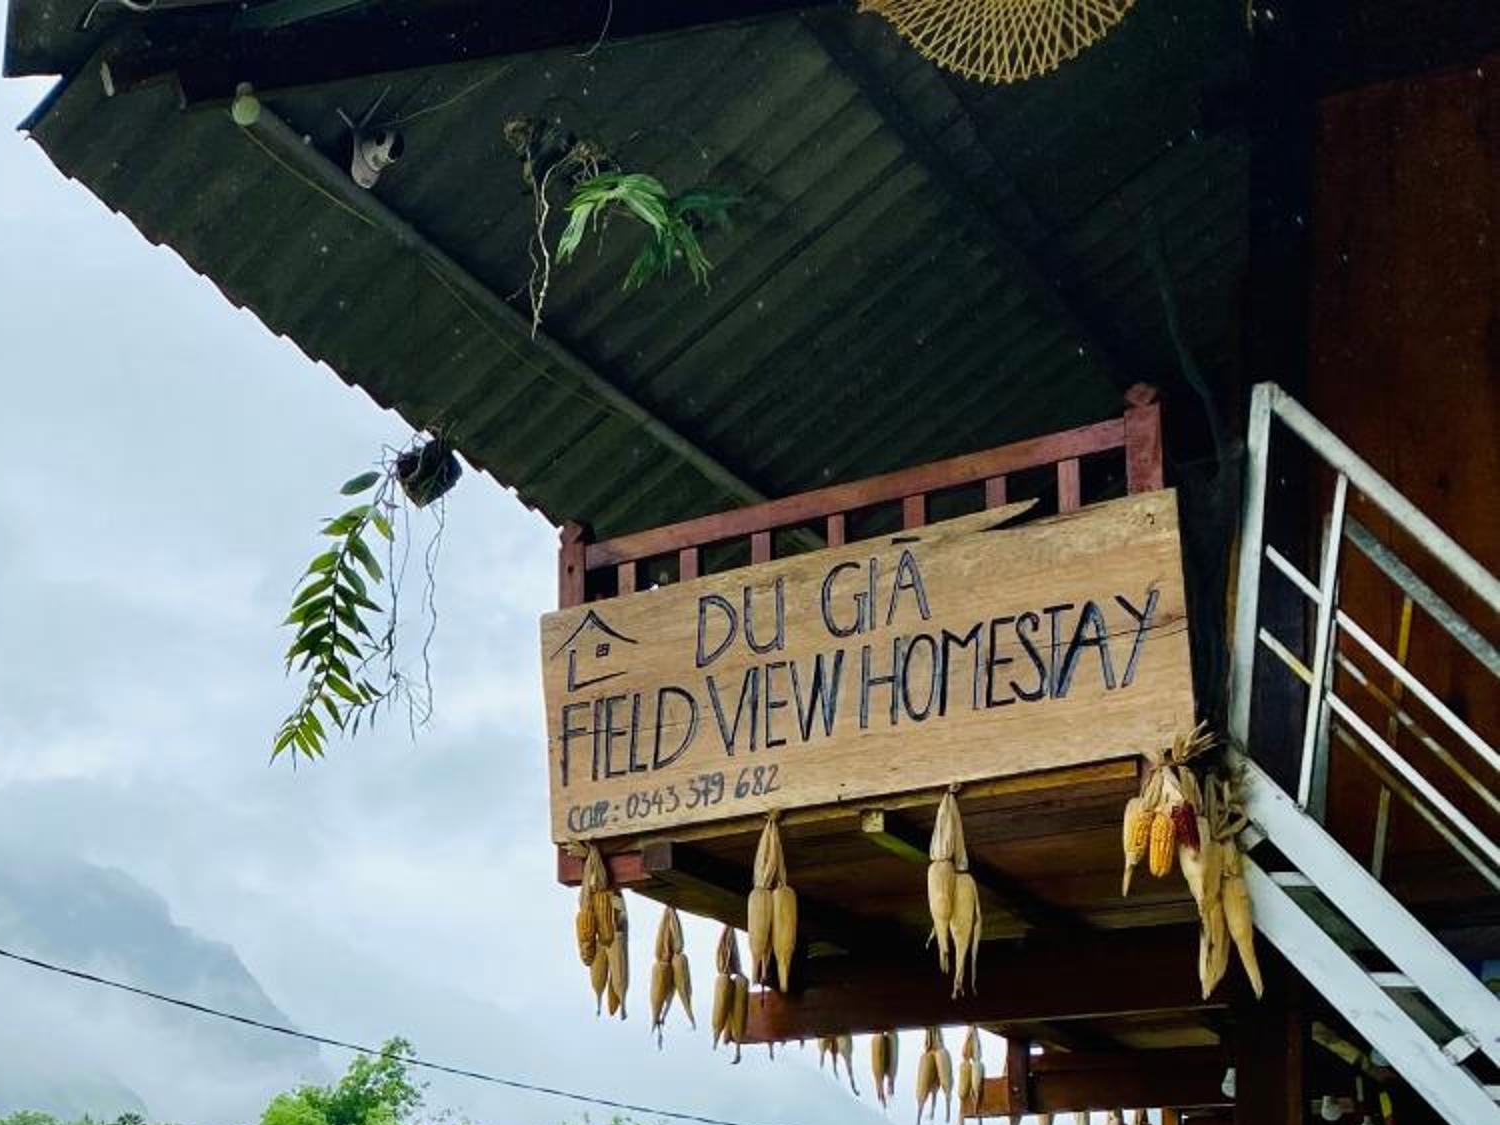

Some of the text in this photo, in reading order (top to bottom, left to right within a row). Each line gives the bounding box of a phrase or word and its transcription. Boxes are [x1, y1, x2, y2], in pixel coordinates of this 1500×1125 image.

[695, 575, 786, 668] DU
[560, 588, 1160, 788] FIELD VIEW HOMESTAY
[625, 785, 681, 819] 0343
[685, 771, 725, 810] 379
[733, 763, 781, 799] 682
